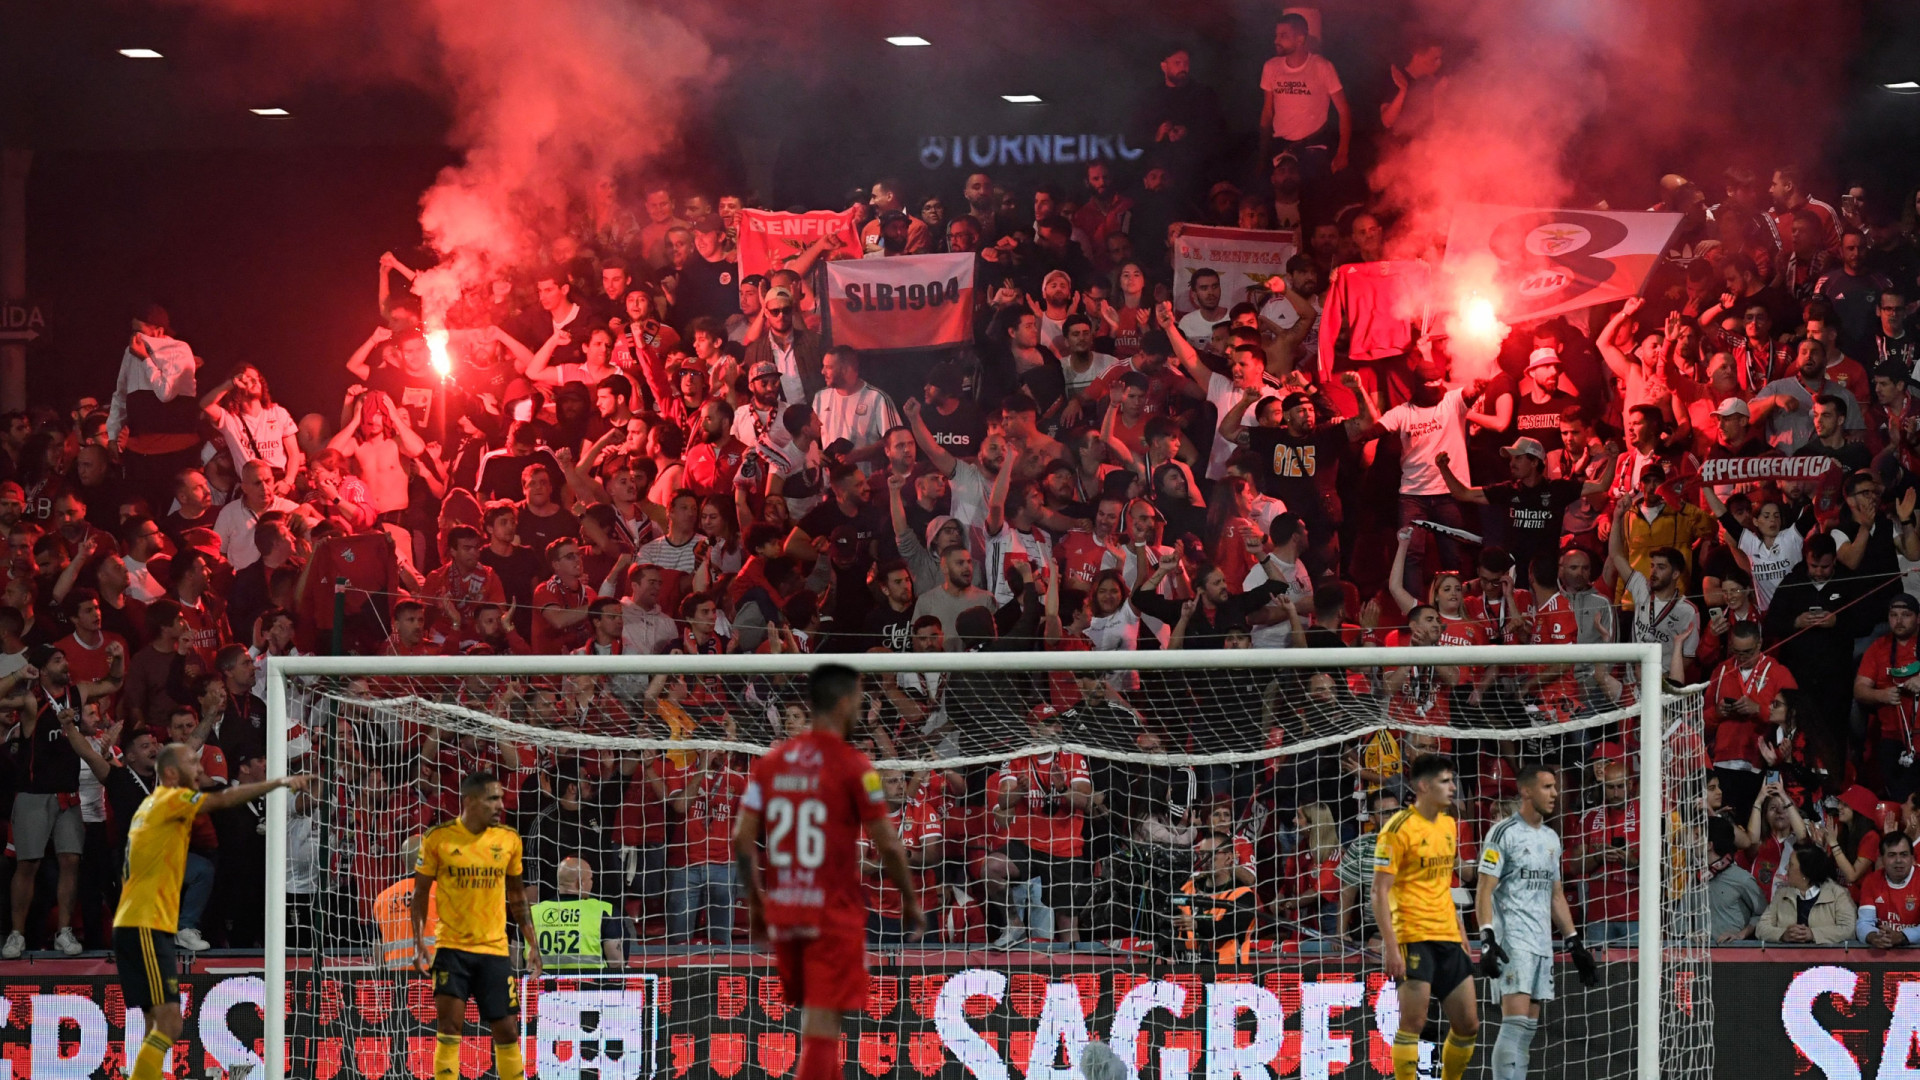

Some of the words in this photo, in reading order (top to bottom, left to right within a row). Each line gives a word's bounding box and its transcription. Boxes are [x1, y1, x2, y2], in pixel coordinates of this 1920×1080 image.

[844, 276, 960, 312] SLB1904
[933, 432, 970, 445] didas
[1273, 443, 1316, 477] 8125
[1701, 455, 1832, 481] #PELOBENFICA
[1509, 507, 1553, 519] Emirates
[1752, 558, 1791, 573] mirates
[766, 797, 827, 868] 26
[448, 864, 505, 877] Emirates
[540, 930, 580, 955] 052
